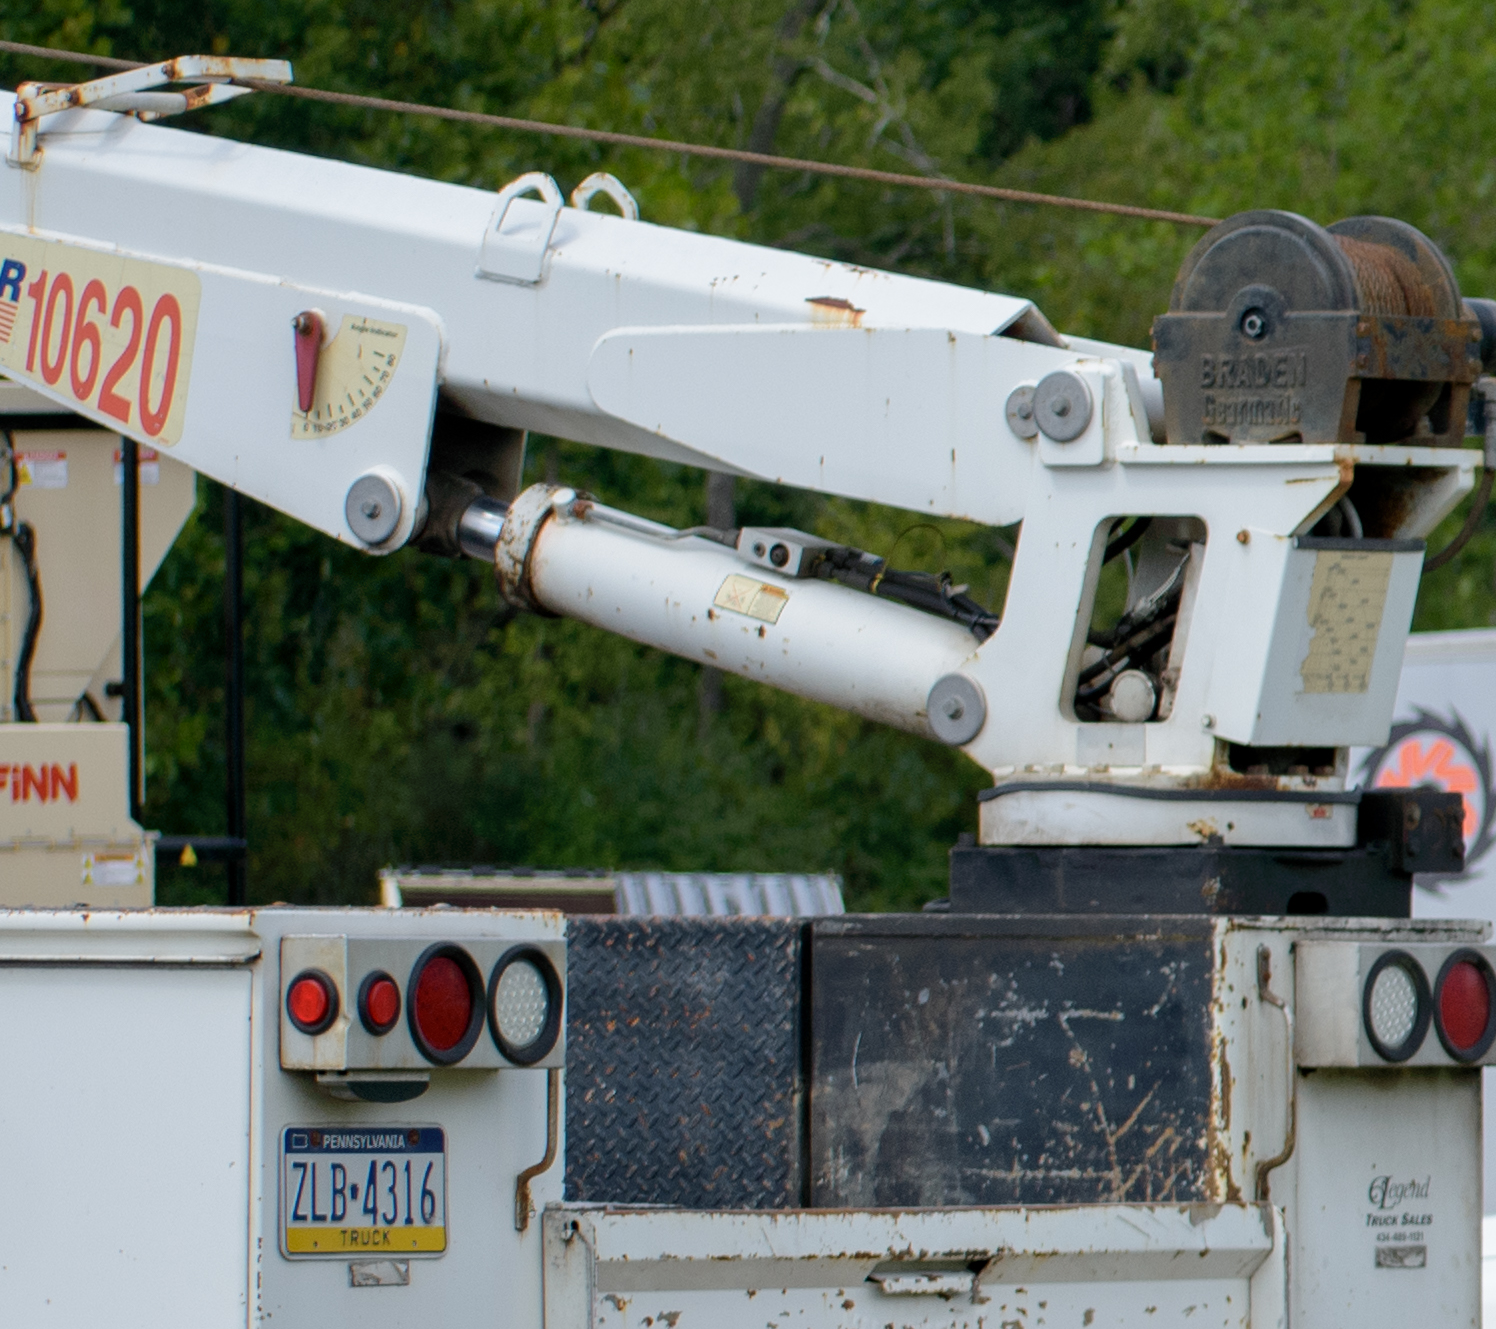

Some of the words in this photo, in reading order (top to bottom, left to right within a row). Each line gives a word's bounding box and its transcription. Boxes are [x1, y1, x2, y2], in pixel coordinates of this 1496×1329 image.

[25, 268, 182, 437] 10620
[323, 1133, 406, 1149] PENNSYLVANIA
[1368, 1174, 1432, 1210] Legend
[340, 1230, 392, 1246] TRUCK
